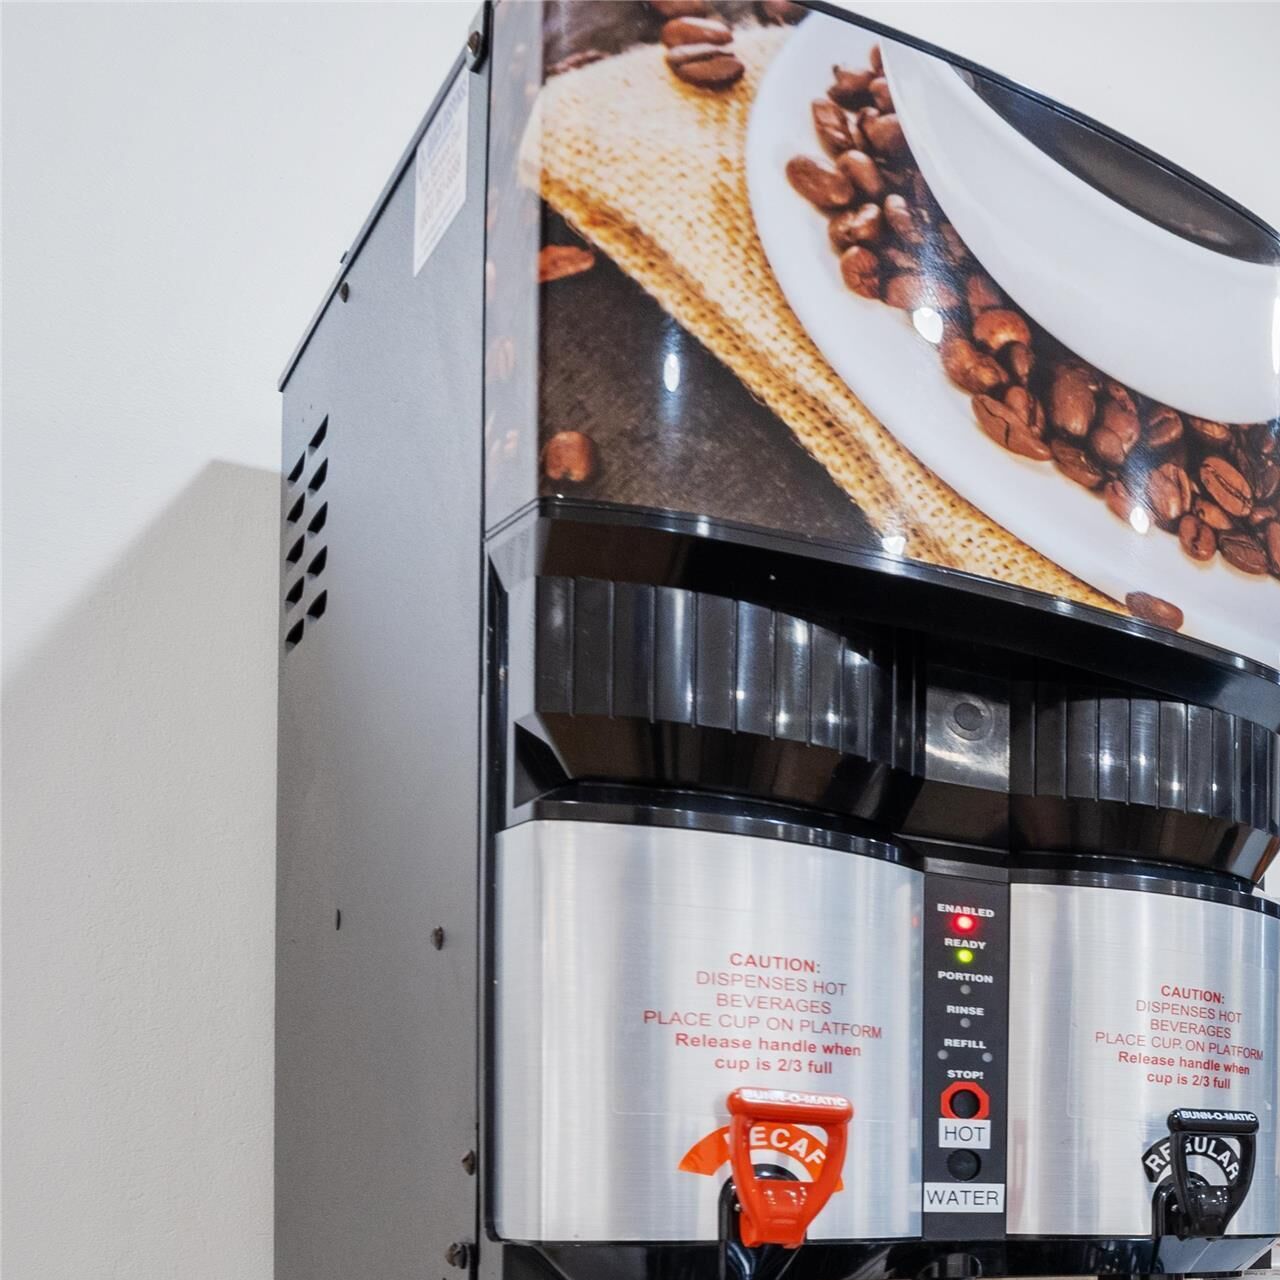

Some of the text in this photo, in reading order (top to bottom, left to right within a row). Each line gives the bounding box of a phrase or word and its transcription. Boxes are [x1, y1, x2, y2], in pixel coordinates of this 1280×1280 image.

[937, 903, 995, 917] ENABLED
[944, 937, 987, 950] READY
[729, 953, 821, 974] CAUTION:
[696, 970, 847, 997] DISPENSES HOT
[938, 970, 993, 983] PORTION
[716, 992, 832, 1015] BEVERAGES
[1160, 985, 1225, 1005] CAUTION:
[946, 1005, 984, 1016] RINSE
[1136, 999, 1242, 1023] DISPENSES HOT
[643, 1010, 882, 1039] PLACE CUP ON PLATFORM
[1150, 1018, 1232, 1039] BEVERAGES
[675, 1032, 861, 1056] Release handle when
[944, 1038, 987, 1049] REFILL
[1095, 1031, 1263, 1061] PLACE CUP ON PLATFORM
[714, 1057, 833, 1074] cup is 2/3 full
[1118, 1051, 1250, 1075] Release handle when
[947, 1069, 984, 1079] STOP!
[1147, 1073, 1231, 1090] cup is 2/3 full
[1180, 1110, 1256, 1122] BUNN-O-MATIC
[944, 1126, 986, 1141] HOT
[926, 1190, 999, 1206] WATER
